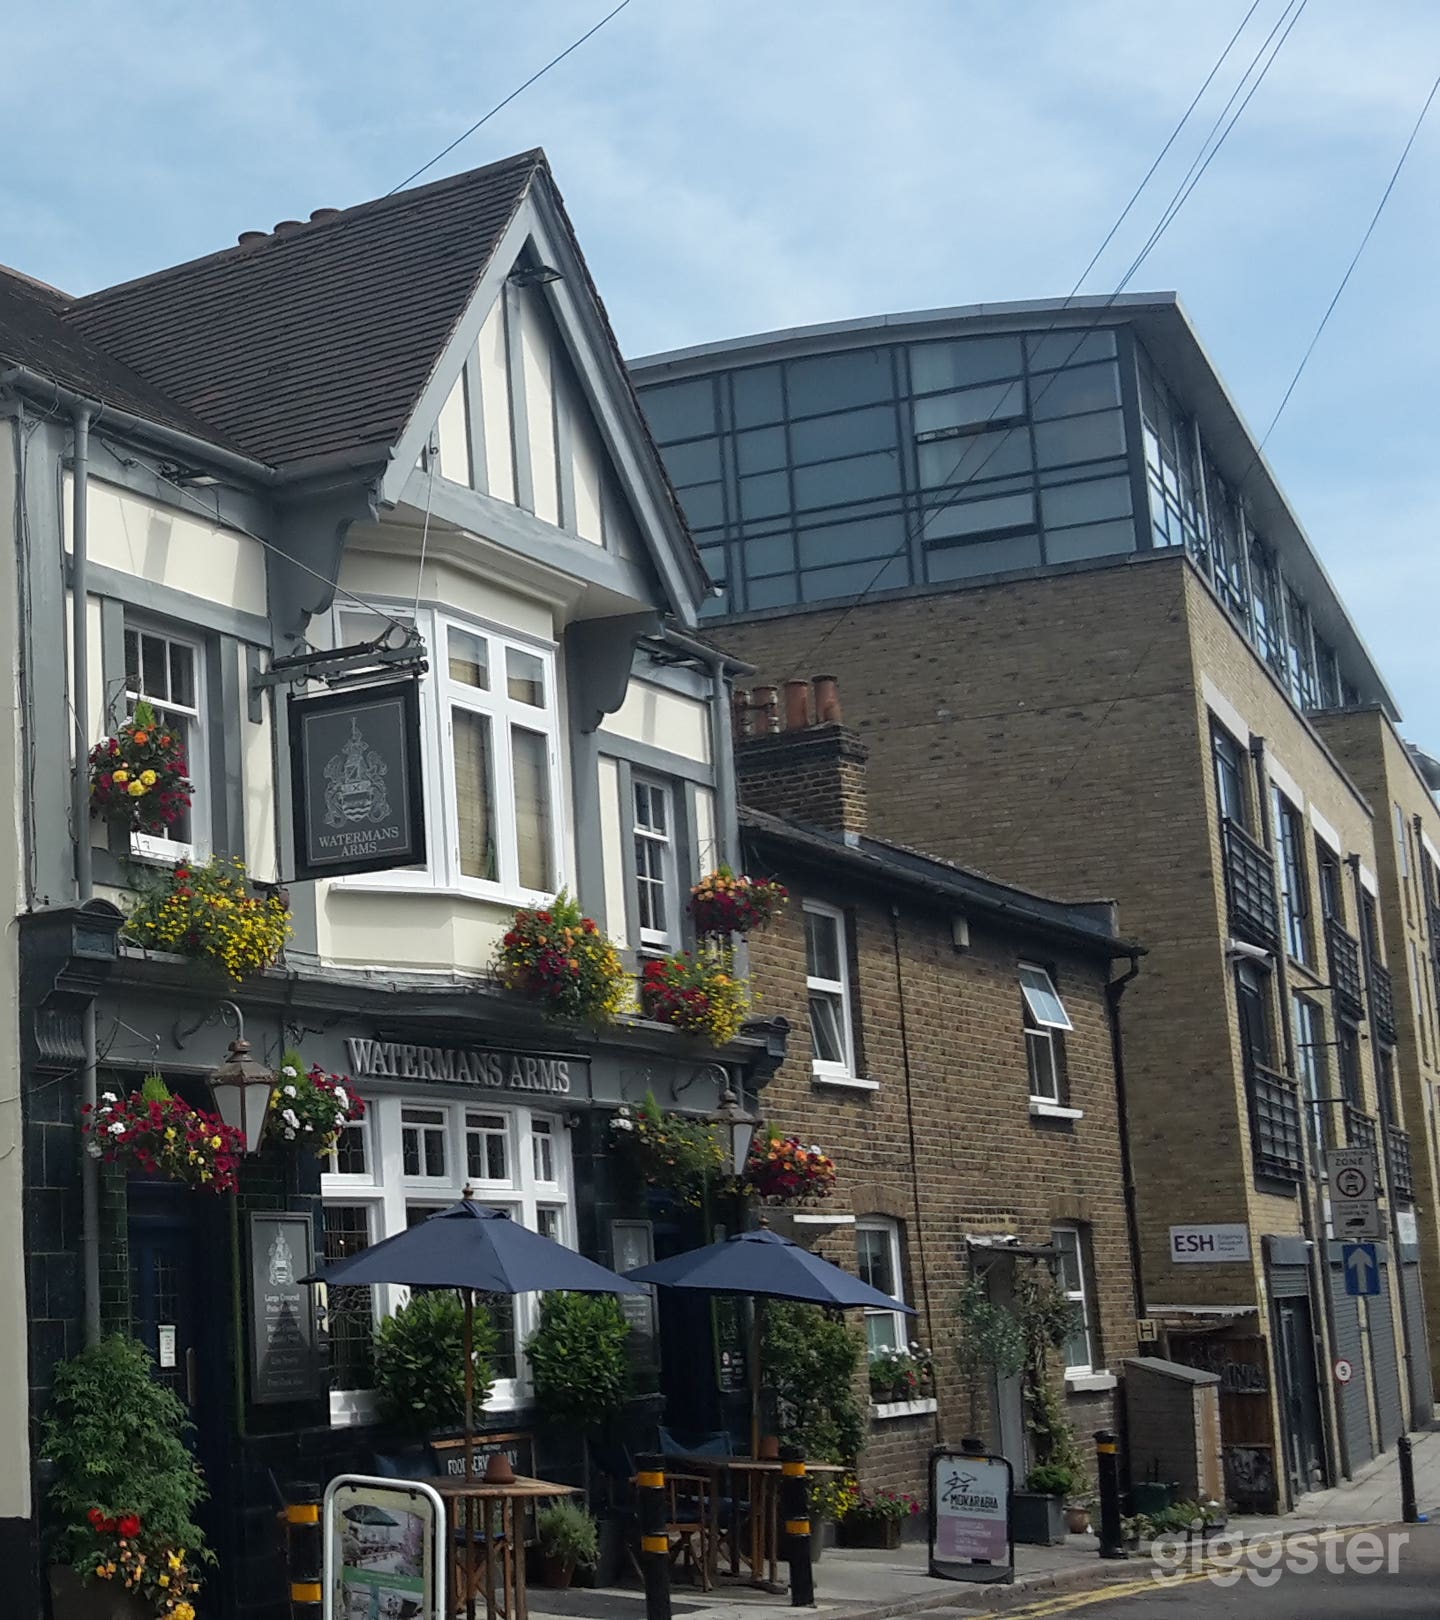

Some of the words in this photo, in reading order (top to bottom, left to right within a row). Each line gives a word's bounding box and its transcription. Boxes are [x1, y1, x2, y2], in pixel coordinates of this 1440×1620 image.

[319, 827, 399, 847] WATERMANS
[341, 842, 377, 857] ARMS
[345, 1037, 503, 1087] WATERMANS
[509, 1056, 570, 1094] ARMS
[1335, 1157, 1364, 1167] ZONE
[1174, 1234, 1215, 1252] ESH
[1340, 1365, 1347, 1376] 5
[950, 1494, 999, 1509] MOKARABIA
